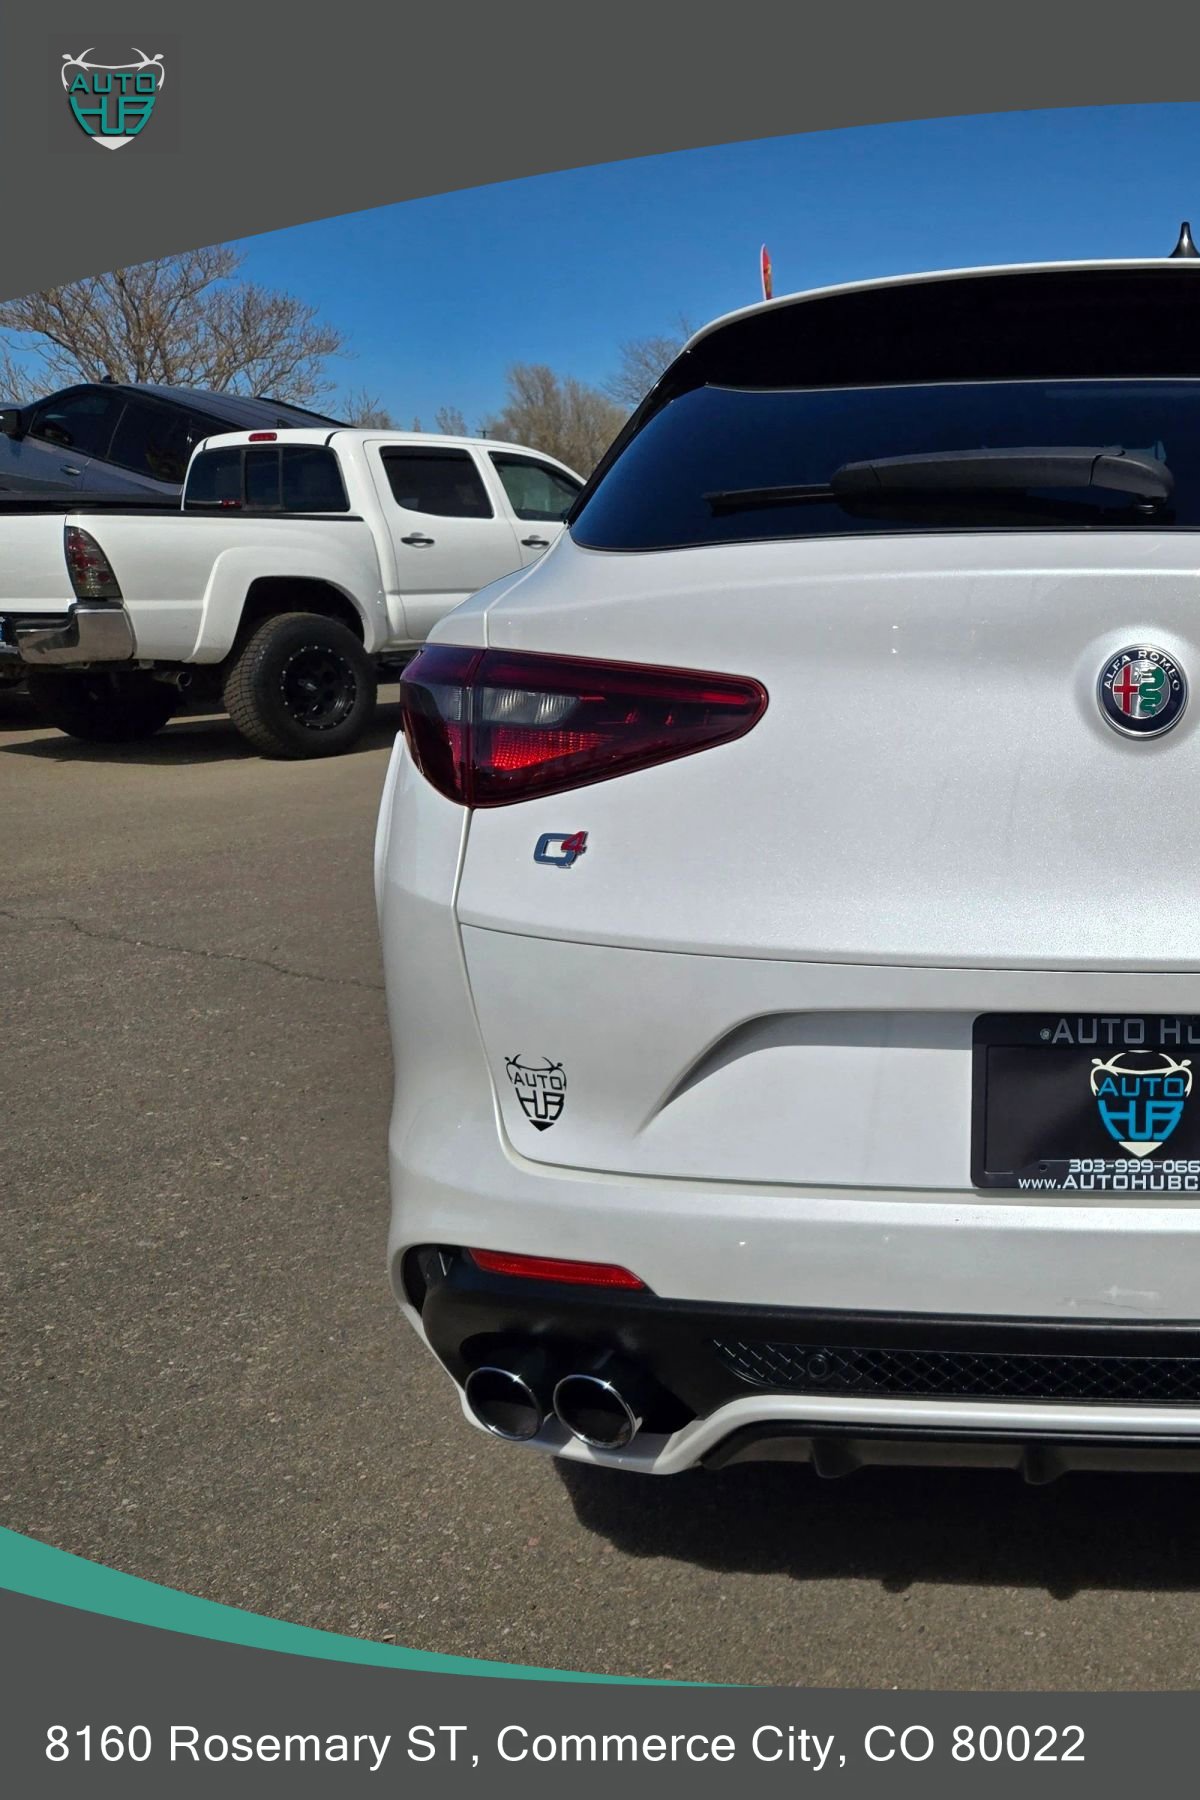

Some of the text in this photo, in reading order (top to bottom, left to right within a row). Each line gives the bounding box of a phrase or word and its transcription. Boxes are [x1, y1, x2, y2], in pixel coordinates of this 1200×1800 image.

[1104, 650, 1180, 692] ALFA ROMEO
[1051, 1017, 1146, 1045] AUTO
[513, 1071, 563, 1091] AUTO
[1098, 1076, 1184, 1098] AUTO
[1097, 1099, 1186, 1141] HUB
